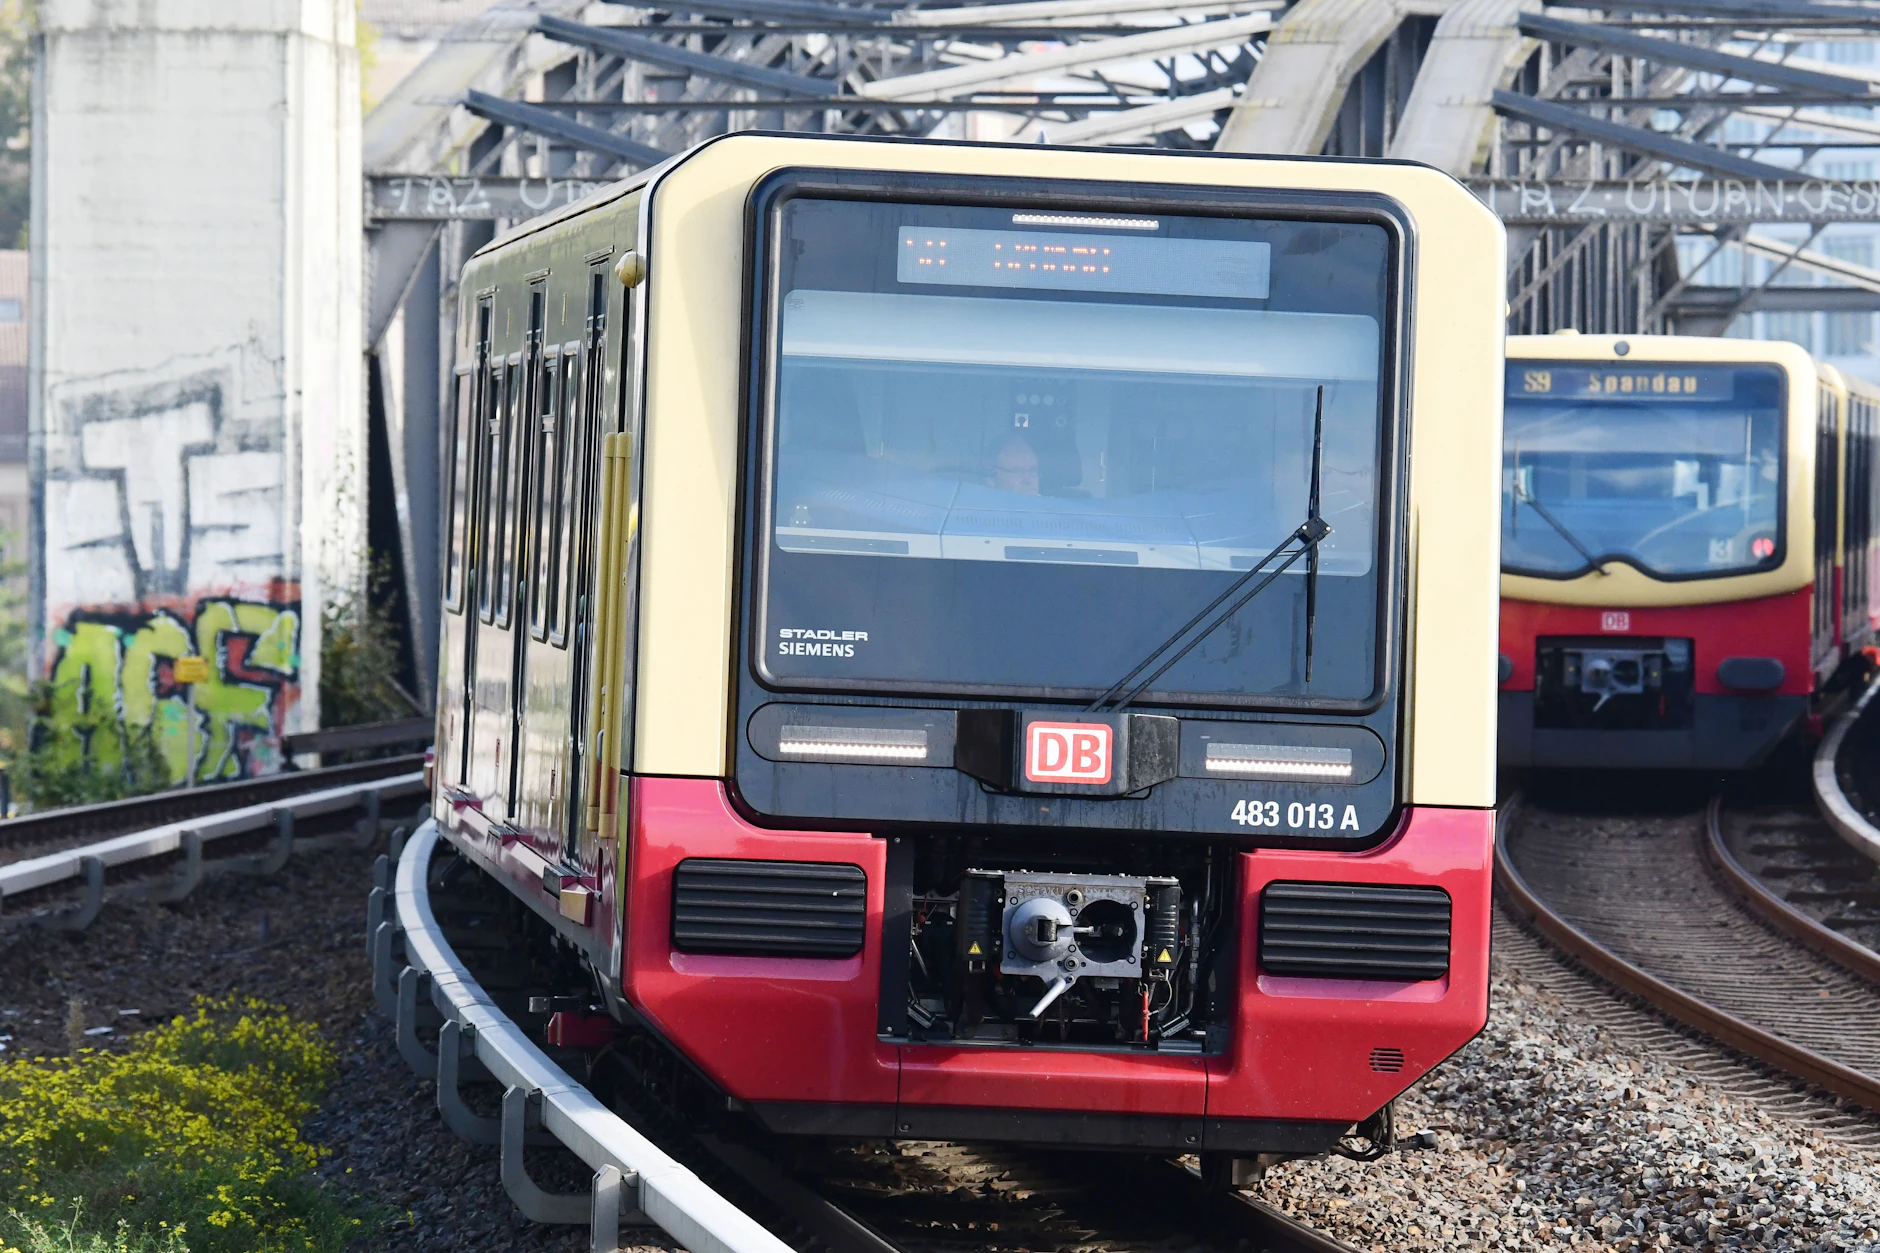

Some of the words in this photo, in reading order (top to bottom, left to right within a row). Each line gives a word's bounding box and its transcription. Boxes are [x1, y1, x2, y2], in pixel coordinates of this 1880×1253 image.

[1524, 371, 1552, 393] S9
[1589, 373, 1698, 393] Spandau
[780, 628, 869, 642] STADLER
[779, 642, 854, 657] SIEMENS
[1037, 731, 1102, 774] DB
[1230, 799, 1280, 827] 483
[1287, 802, 1334, 830] 013
[1340, 804, 1360, 831] A
